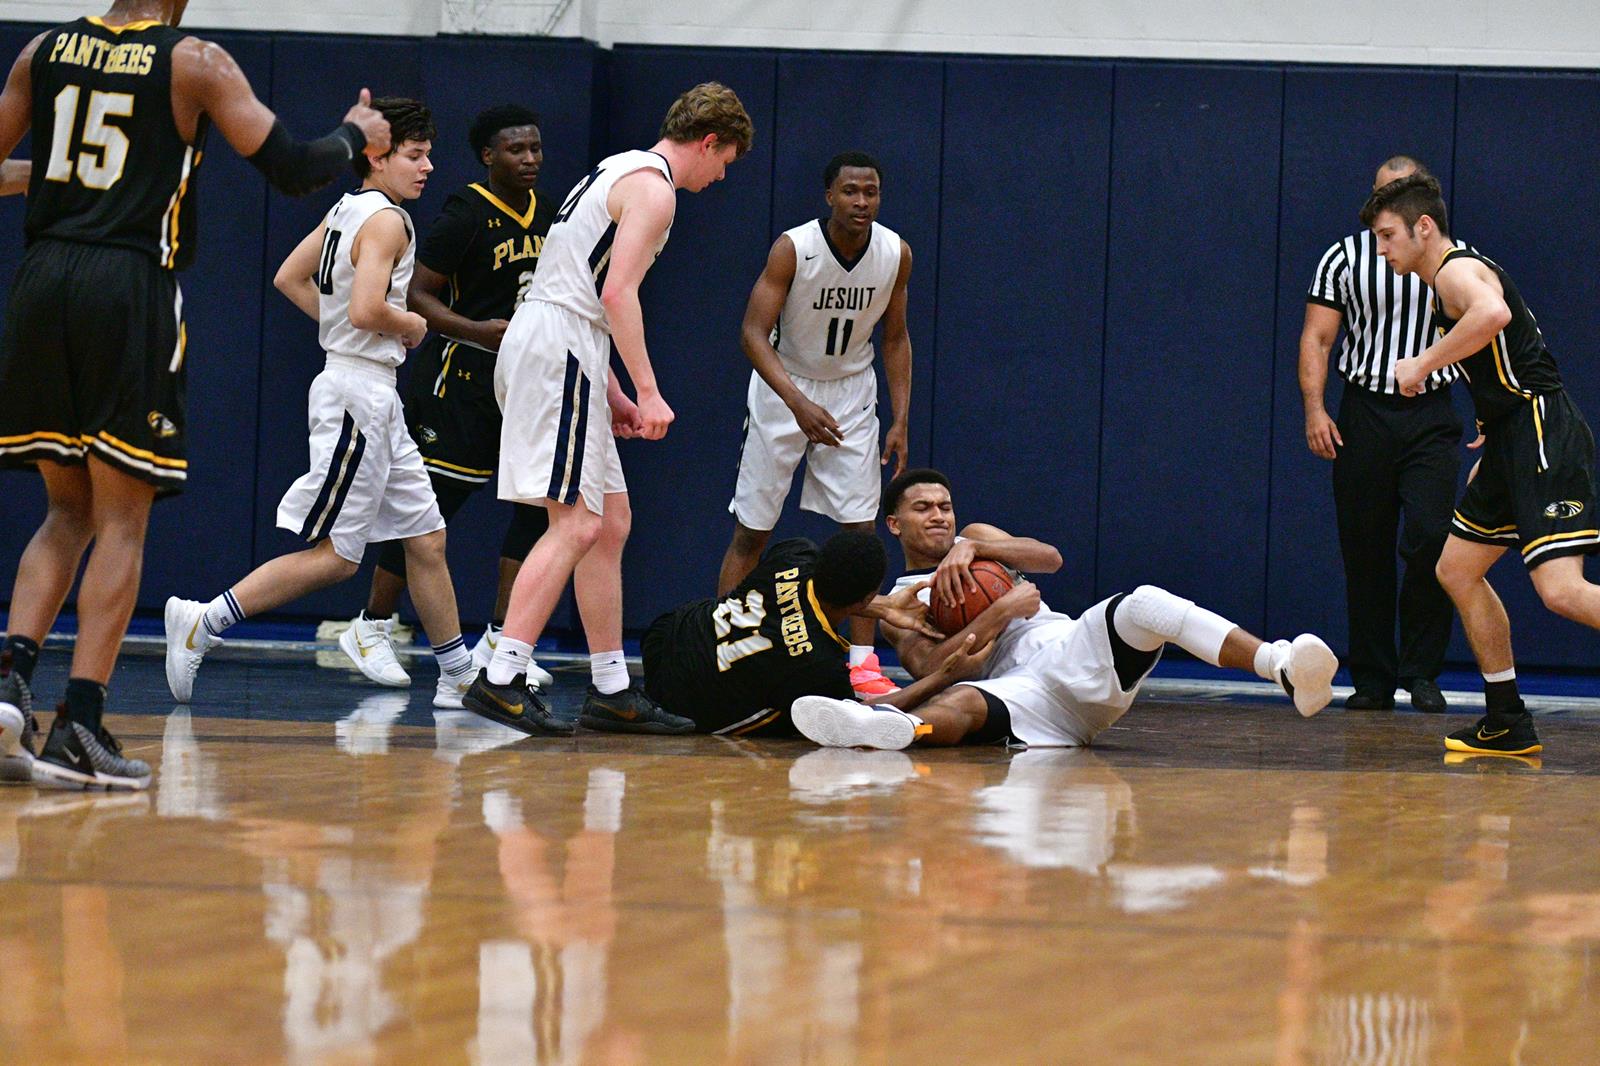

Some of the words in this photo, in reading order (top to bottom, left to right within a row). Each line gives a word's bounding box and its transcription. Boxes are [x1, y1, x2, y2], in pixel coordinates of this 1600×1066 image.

[49, 32, 157, 76] PANTHERS
[45, 84, 135, 190] 15
[813, 286, 876, 311] JESUIT
[826, 317, 854, 356] 11
[712, 589, 773, 672] 21
[775, 567, 813, 657] PANTHERS
